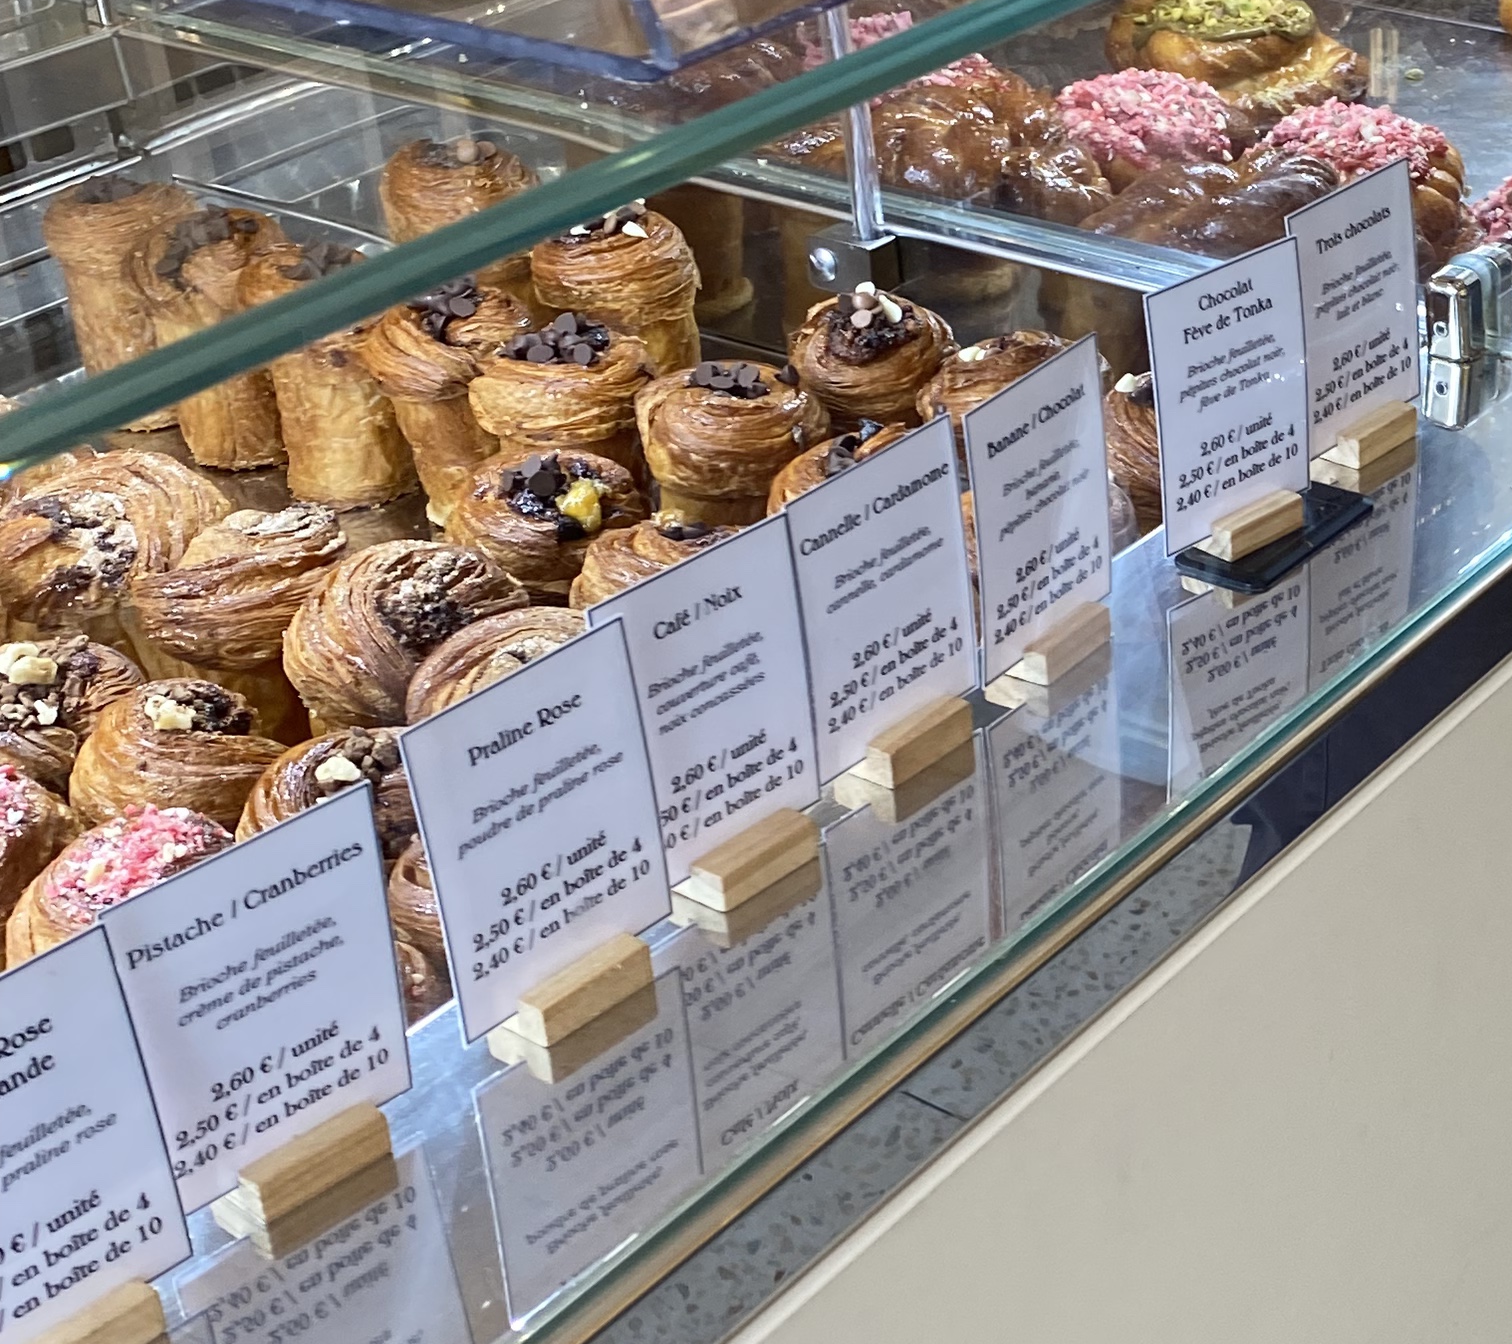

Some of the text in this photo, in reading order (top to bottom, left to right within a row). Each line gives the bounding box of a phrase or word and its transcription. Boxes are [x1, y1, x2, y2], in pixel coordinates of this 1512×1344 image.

[1315, 232, 1343, 255] Trois
[1183, 297, 1273, 345] Fève de Tonka
[1198, 278, 1254, 312] Chocolat
[1386, 366, 1399, 381] de
[1400, 355, 1412, 373] 10
[1388, 344, 1401, 359] de
[986, 384, 1086, 459] Banane Chocolat
[1223, 385, 1237, 399] de
[1206, 460, 1214, 476] €
[1224, 454, 1239, 468] en
[1240, 439, 1269, 460] boîte
[1270, 430, 1285, 446] de
[1287, 423, 1295, 437] 4
[1227, 429, 1236, 444] €
[1245, 412, 1273, 436] unité
[1203, 484, 1212, 499] €
[1221, 476, 1236, 490] en
[1238, 462, 1266, 483] boîte
[1267, 452, 1282, 468] de
[1285, 442, 1299, 460] 10
[799, 513, 862, 557] Cannelle
[872, 462, 949, 515] Cardamome
[1075, 569, 1089, 585] de
[1090, 555, 1103, 575] 10
[1077, 544, 1091, 561] de
[653, 586, 743, 640] Café Noix
[901, 607, 933, 638] unité
[878, 685, 895, 702] en
[929, 651, 945, 669] de
[948, 636, 963, 657] 10
[880, 659, 897, 676] en
[931, 626, 947, 644] de
[949, 616, 958, 631] 4
[467, 694, 581, 767] Praline Rose
[707, 755, 717, 773] €
[730, 728, 767, 760] unité
[472, 784, 529, 824] Brioche
[679, 759, 804, 841] € en boîte de 10
[681, 737, 798, 814] € en boîte de 4
[458, 751, 624, 861] poudre de praline rose
[472, 837, 642, 953] 2,50 € en boîte de 4
[500, 830, 607, 907] 2,60 € unité
[125, 842, 364, 970] Pistache / Cranberries
[472, 947, 510, 981] 2,40
[513, 937, 524, 954] €
[539, 920, 561, 939] en
[607, 878, 627, 897] de
[631, 859, 650, 882] 10
[178, 991, 233, 1027] crème
[238, 976, 262, 996] de
[179, 960, 248, 1004] Brioche
[216, 970, 317, 1031] cranberries
[175, 1025, 381, 1151] 2,50 € en boîte de 4
[211, 1020, 339, 1103] 2,60 € unité
[75, 1113, 117, 1144] rose
[222, 1132, 236, 1150] €
[255, 1114, 280, 1134] en
[283, 1084, 333, 1118] boîte
[337, 1068, 360, 1088] de
[367, 1048, 389, 1071] 10
[10, 1190, 100, 1254] € unité
[11, 1192, 150, 1287] en boîte de 4
[12, 1216, 163, 1319] en boîte de 10
